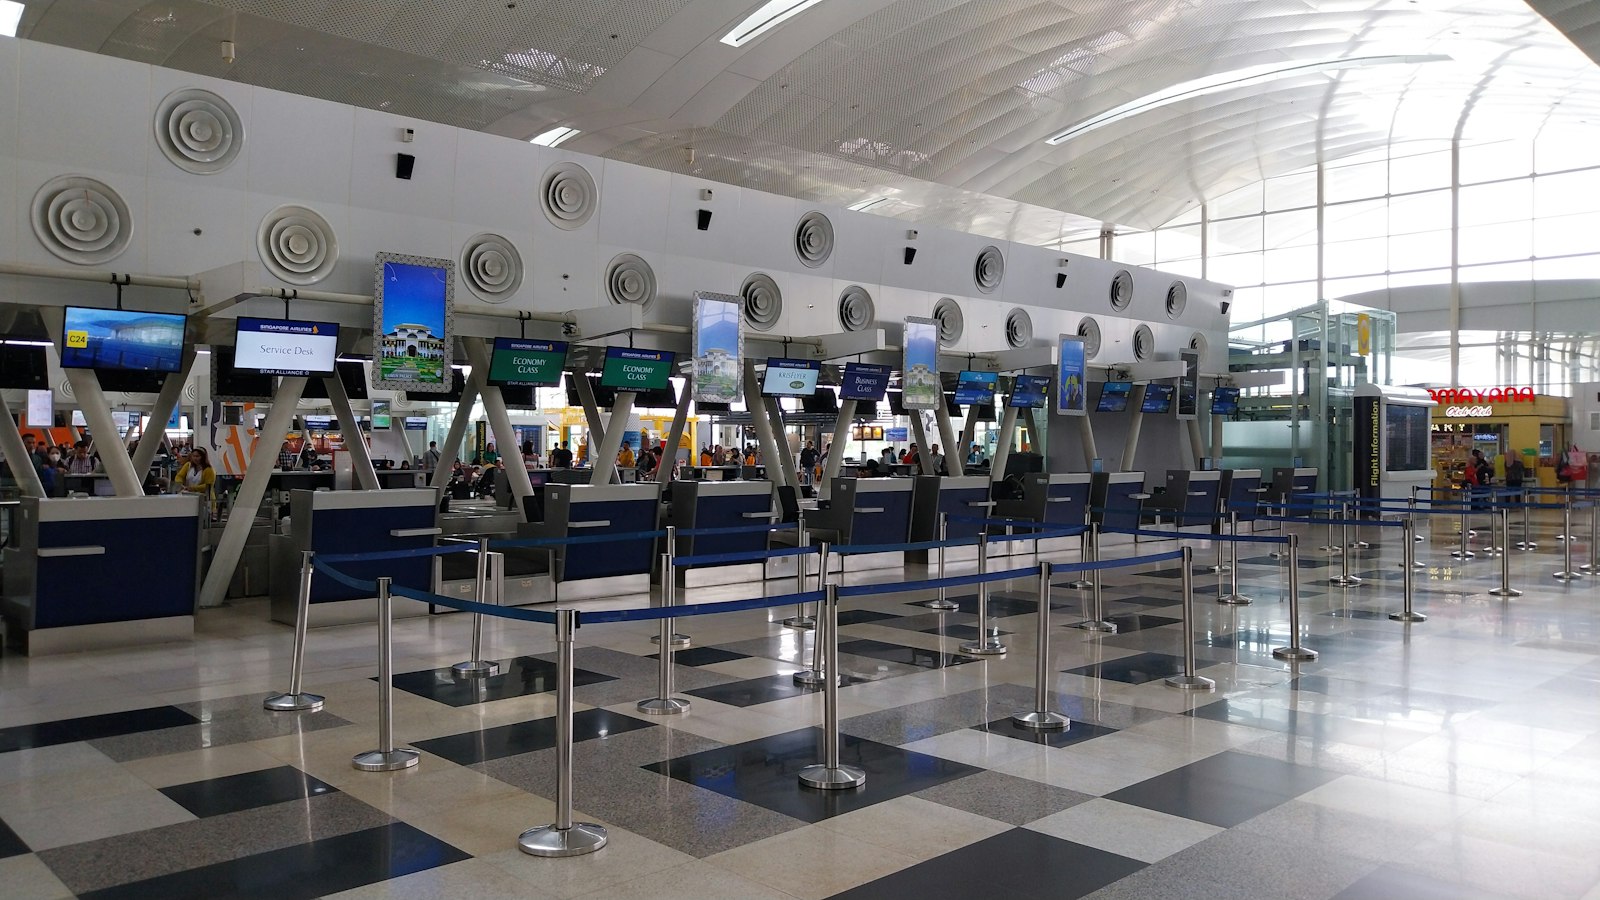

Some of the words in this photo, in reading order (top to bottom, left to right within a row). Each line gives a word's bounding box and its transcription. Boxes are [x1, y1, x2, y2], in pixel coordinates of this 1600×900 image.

[260, 344, 292, 354] Service
[294, 346, 314, 356] Desk
[512, 356, 547, 366] ECONOMY
[517, 366, 539, 374] CLASS
[622, 364, 655, 374] ECONOMY
[627, 373, 647, 381] CLASS
[855, 376, 878, 385] BUSINESS
[857, 385, 872, 393] CLASS
[1371, 401, 1379, 457] Information
[1371, 458, 1379, 487] Flight
